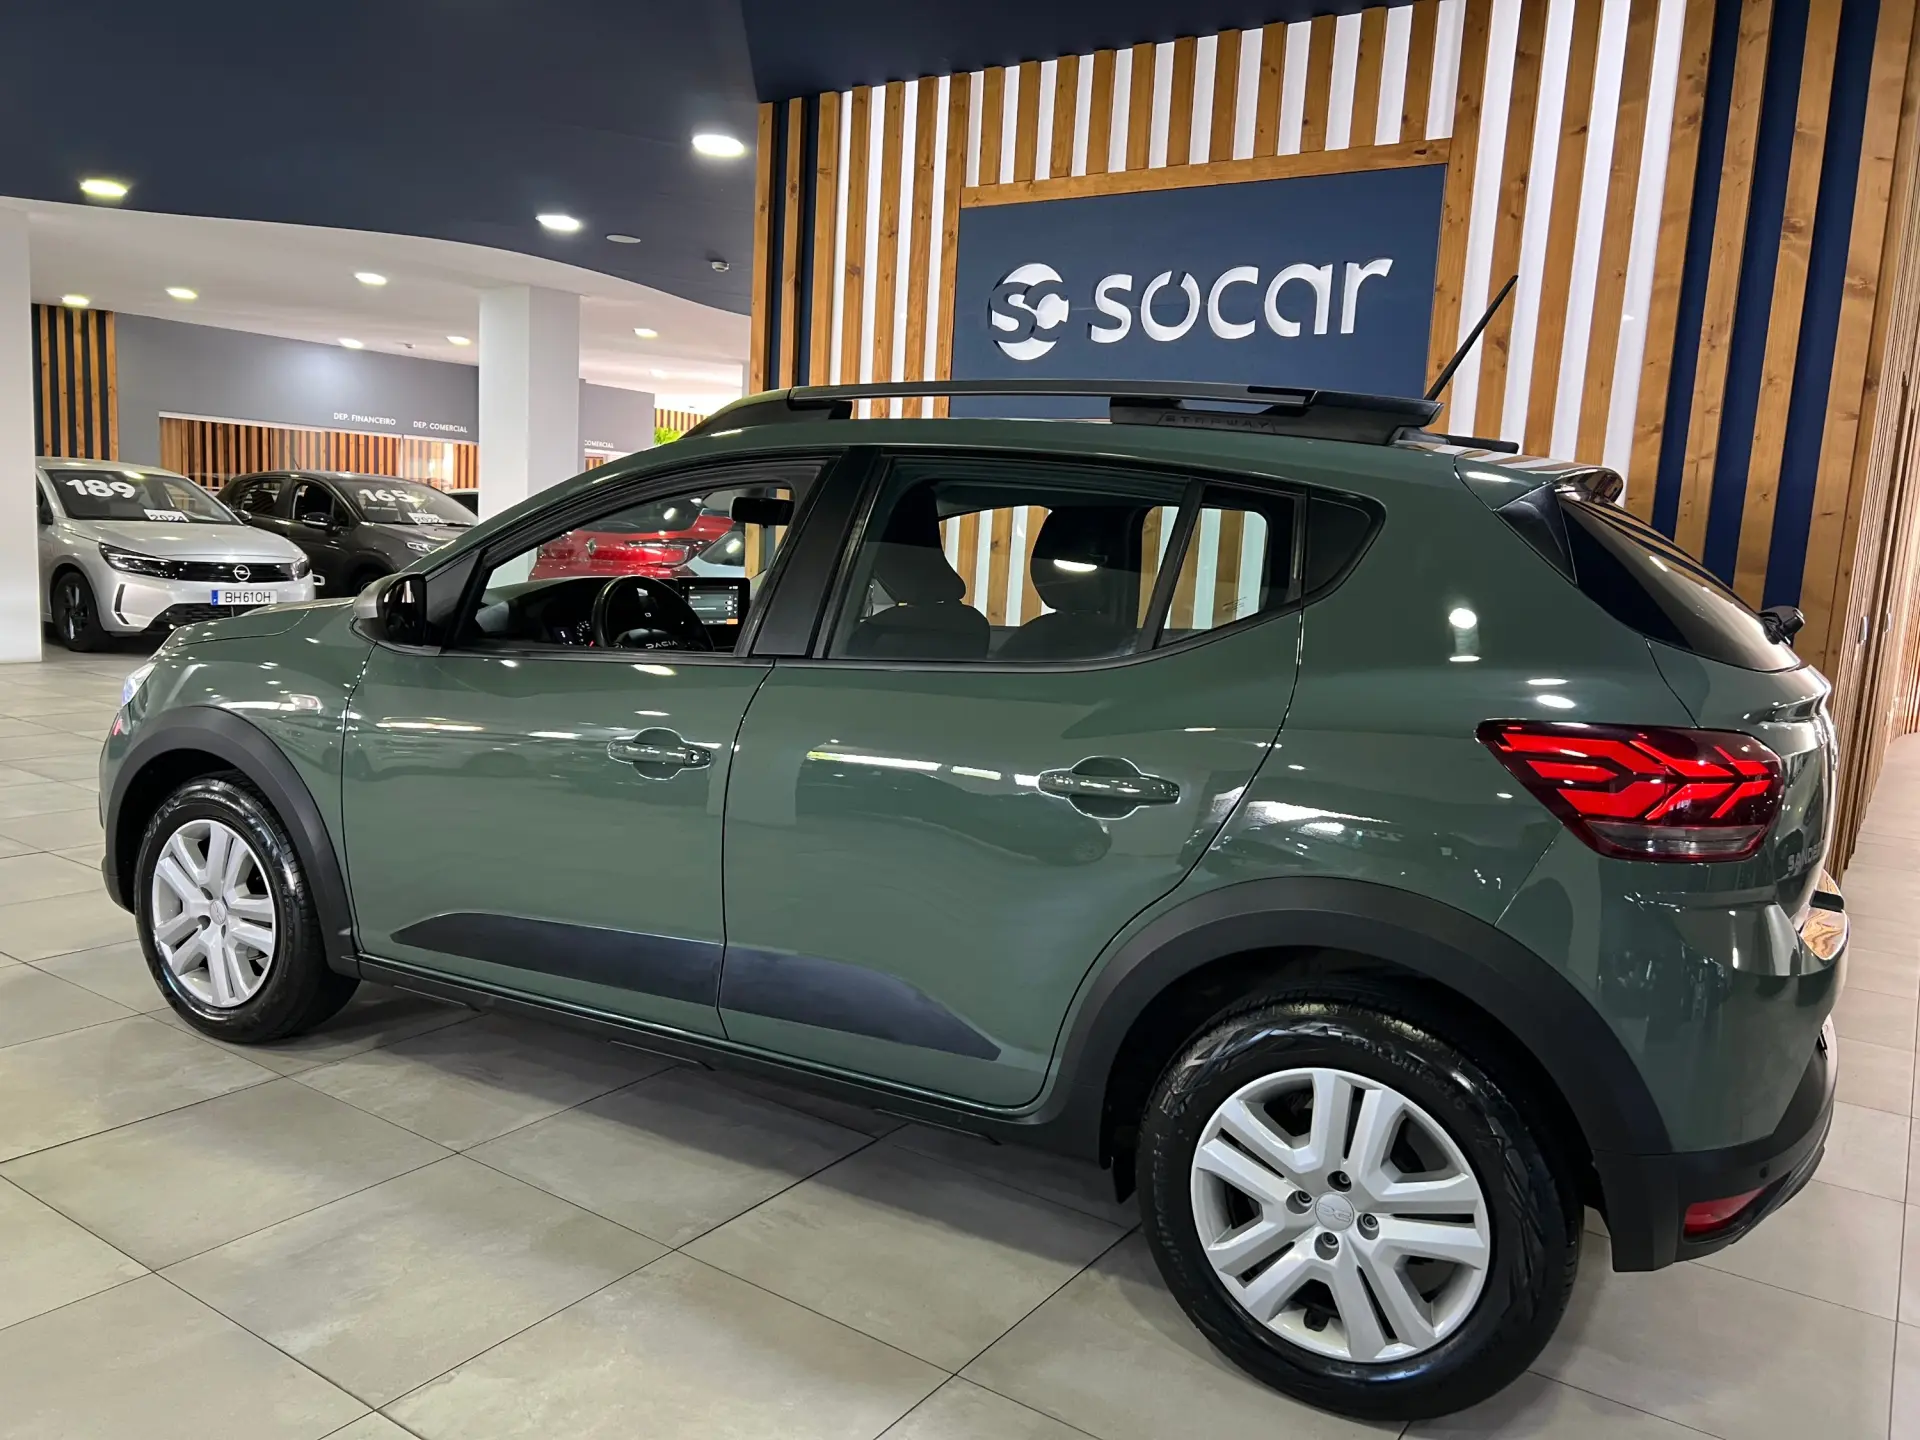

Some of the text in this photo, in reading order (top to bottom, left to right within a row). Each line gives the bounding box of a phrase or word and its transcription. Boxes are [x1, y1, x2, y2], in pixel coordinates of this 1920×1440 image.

[333, 412, 396, 426] DEP. FINANCEIRO
[413, 420, 468, 433] DEP. COMERCIAL
[65, 479, 136, 499] 189
[359, 489, 414, 503] 165
[645, 640, 678, 649] DACIA
